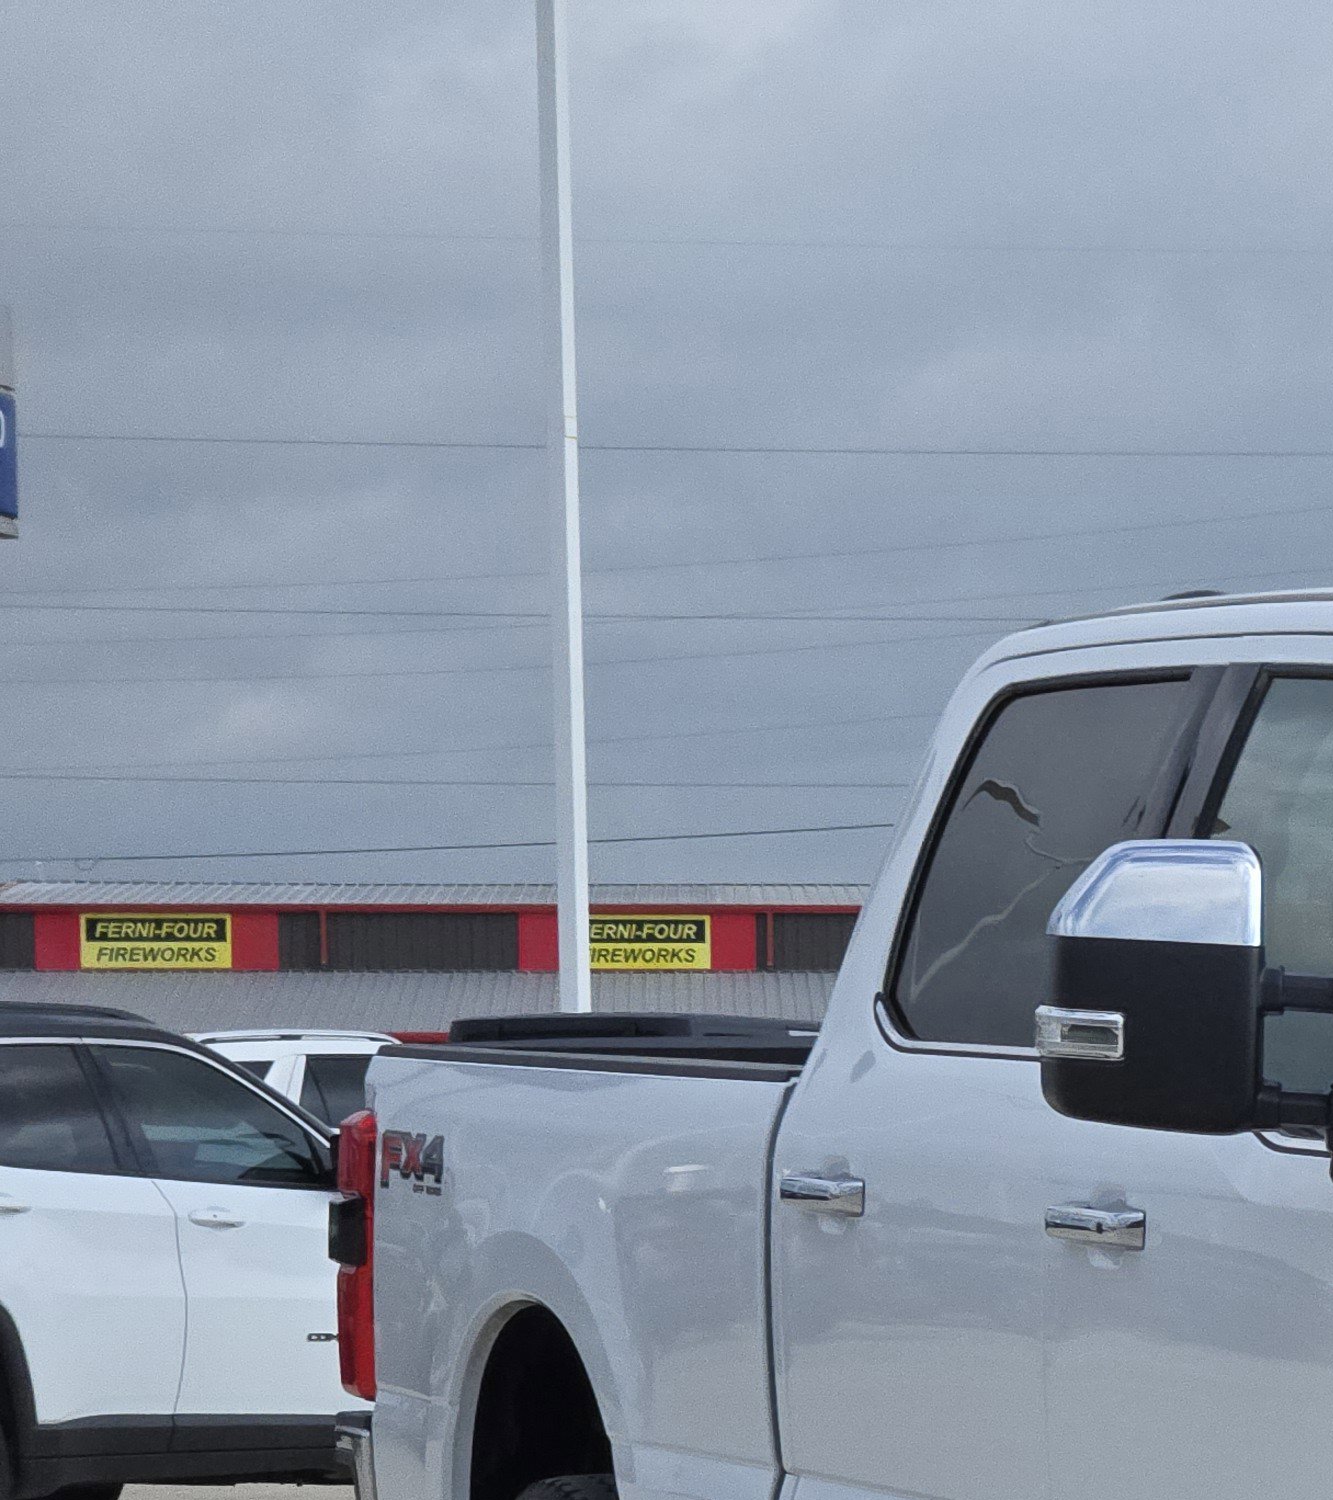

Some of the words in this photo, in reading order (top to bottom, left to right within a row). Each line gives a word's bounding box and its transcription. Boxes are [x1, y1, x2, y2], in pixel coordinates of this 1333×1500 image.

[95, 922, 218, 939] FERNI-FOUR
[589, 923, 698, 940] ERNI-FOUR
[96, 946, 217, 963] FIREWORKS
[589, 947, 697, 964] IREWORKS
[380, 1130, 445, 1189] FX4
